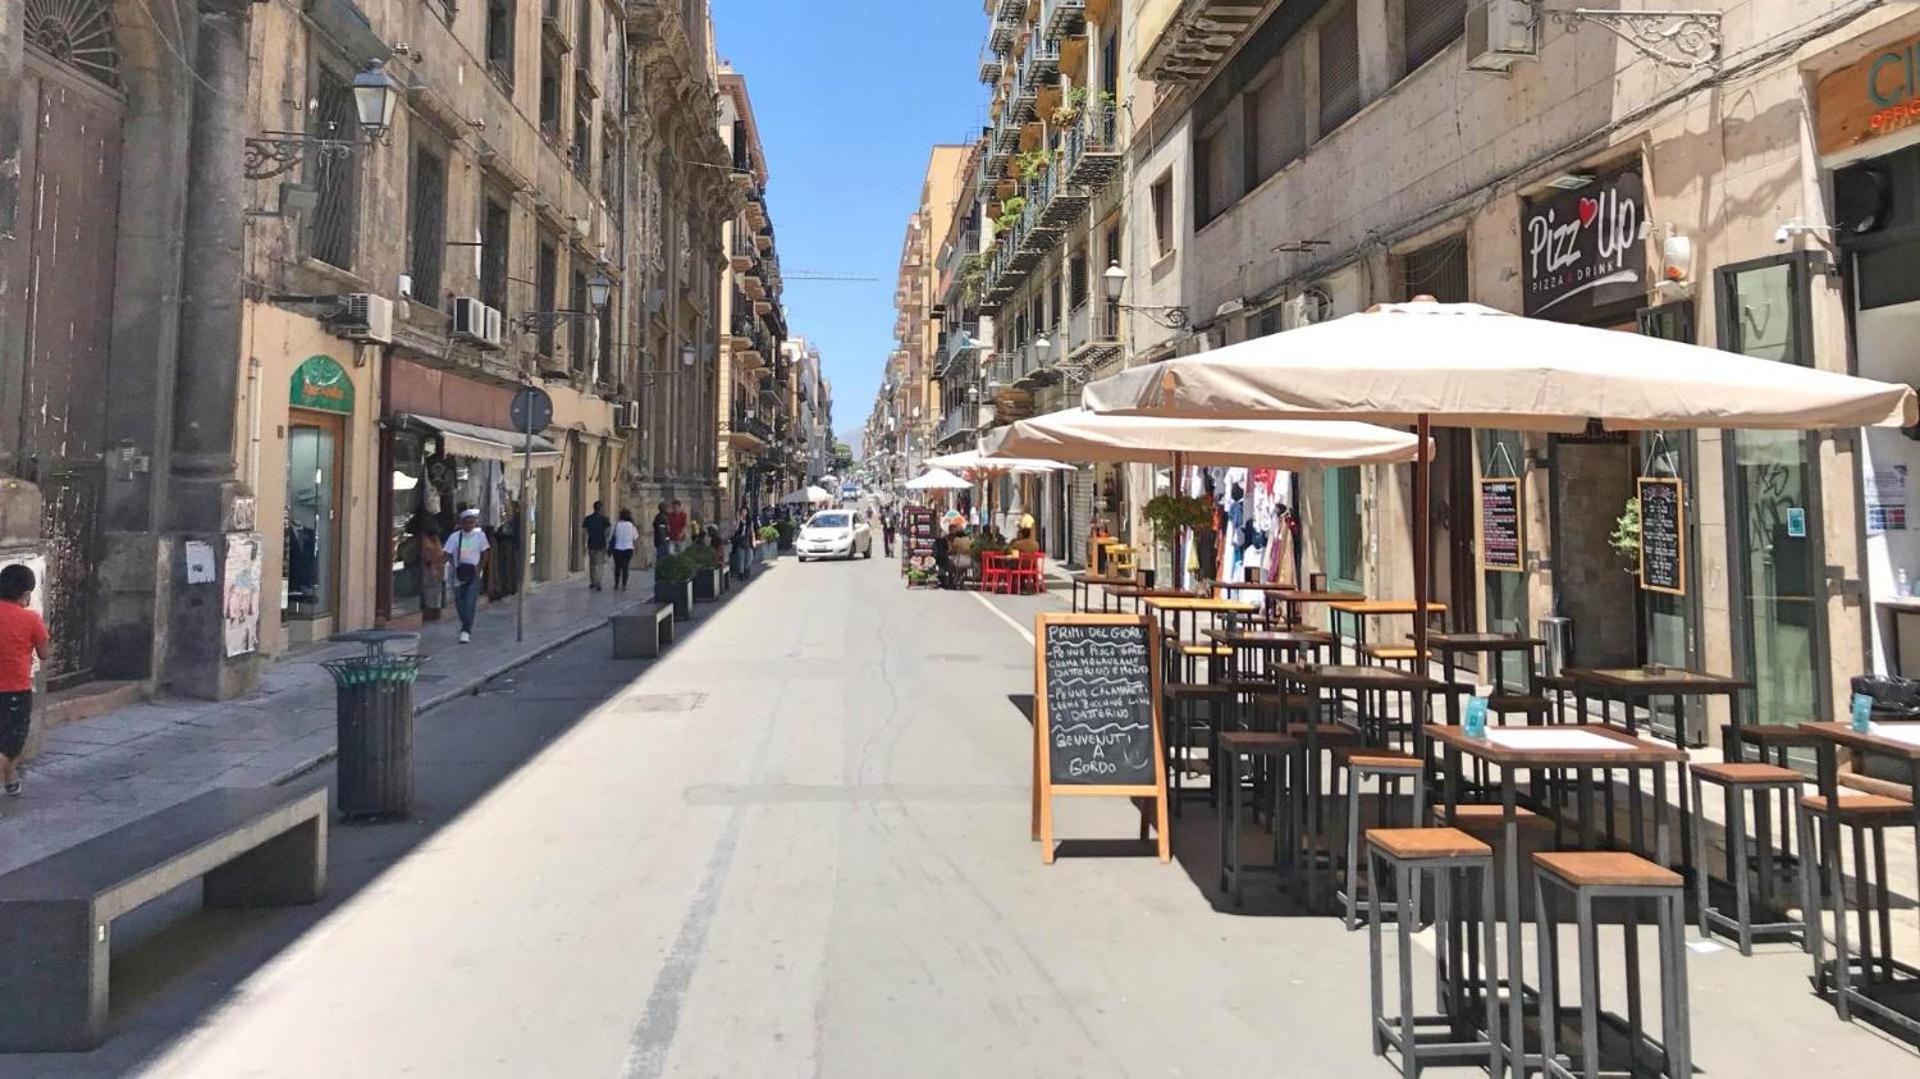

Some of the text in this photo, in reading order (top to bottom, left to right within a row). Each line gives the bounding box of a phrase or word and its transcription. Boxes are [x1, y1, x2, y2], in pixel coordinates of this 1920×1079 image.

[1528, 188, 1635, 279] Pizz Up
[1532, 274, 1564, 293] PIZZA
[1577, 262, 1614, 281] DRINK
[1049, 626, 1084, 639] PRIMI
[1088, 627, 1109, 638] DEL
[1070, 708, 1129, 721] DATTERINO
[1056, 733, 1131, 748] BENVENUTI
[1093, 745, 1105, 759] A
[1069, 757, 1117, 777] GORDO
